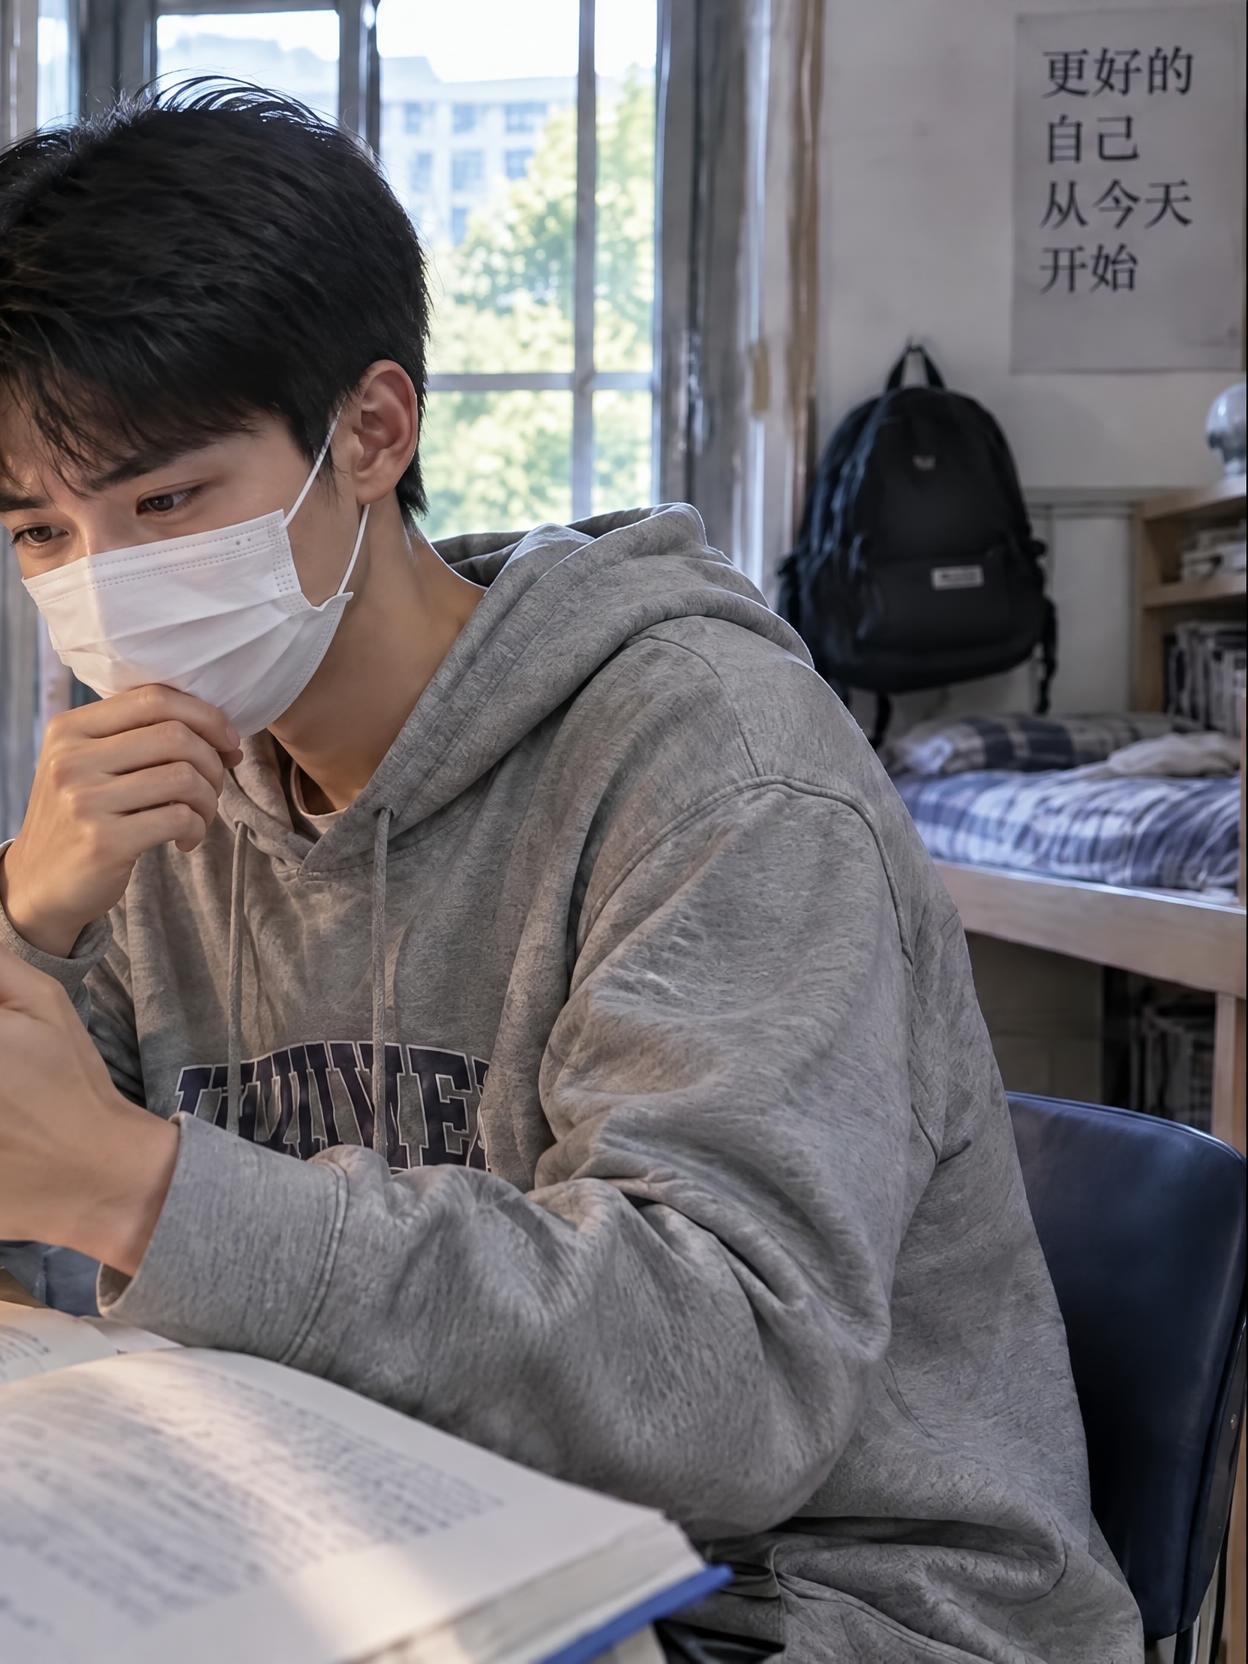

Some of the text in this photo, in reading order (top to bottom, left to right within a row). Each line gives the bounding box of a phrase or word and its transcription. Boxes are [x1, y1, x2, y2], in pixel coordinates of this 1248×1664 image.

[1042, 46, 1193, 98] 更好的
[1047, 114, 1140, 164] 自己
[1040, 178, 1193, 230] 从今天
[1039, 243, 1138, 294] 开始
